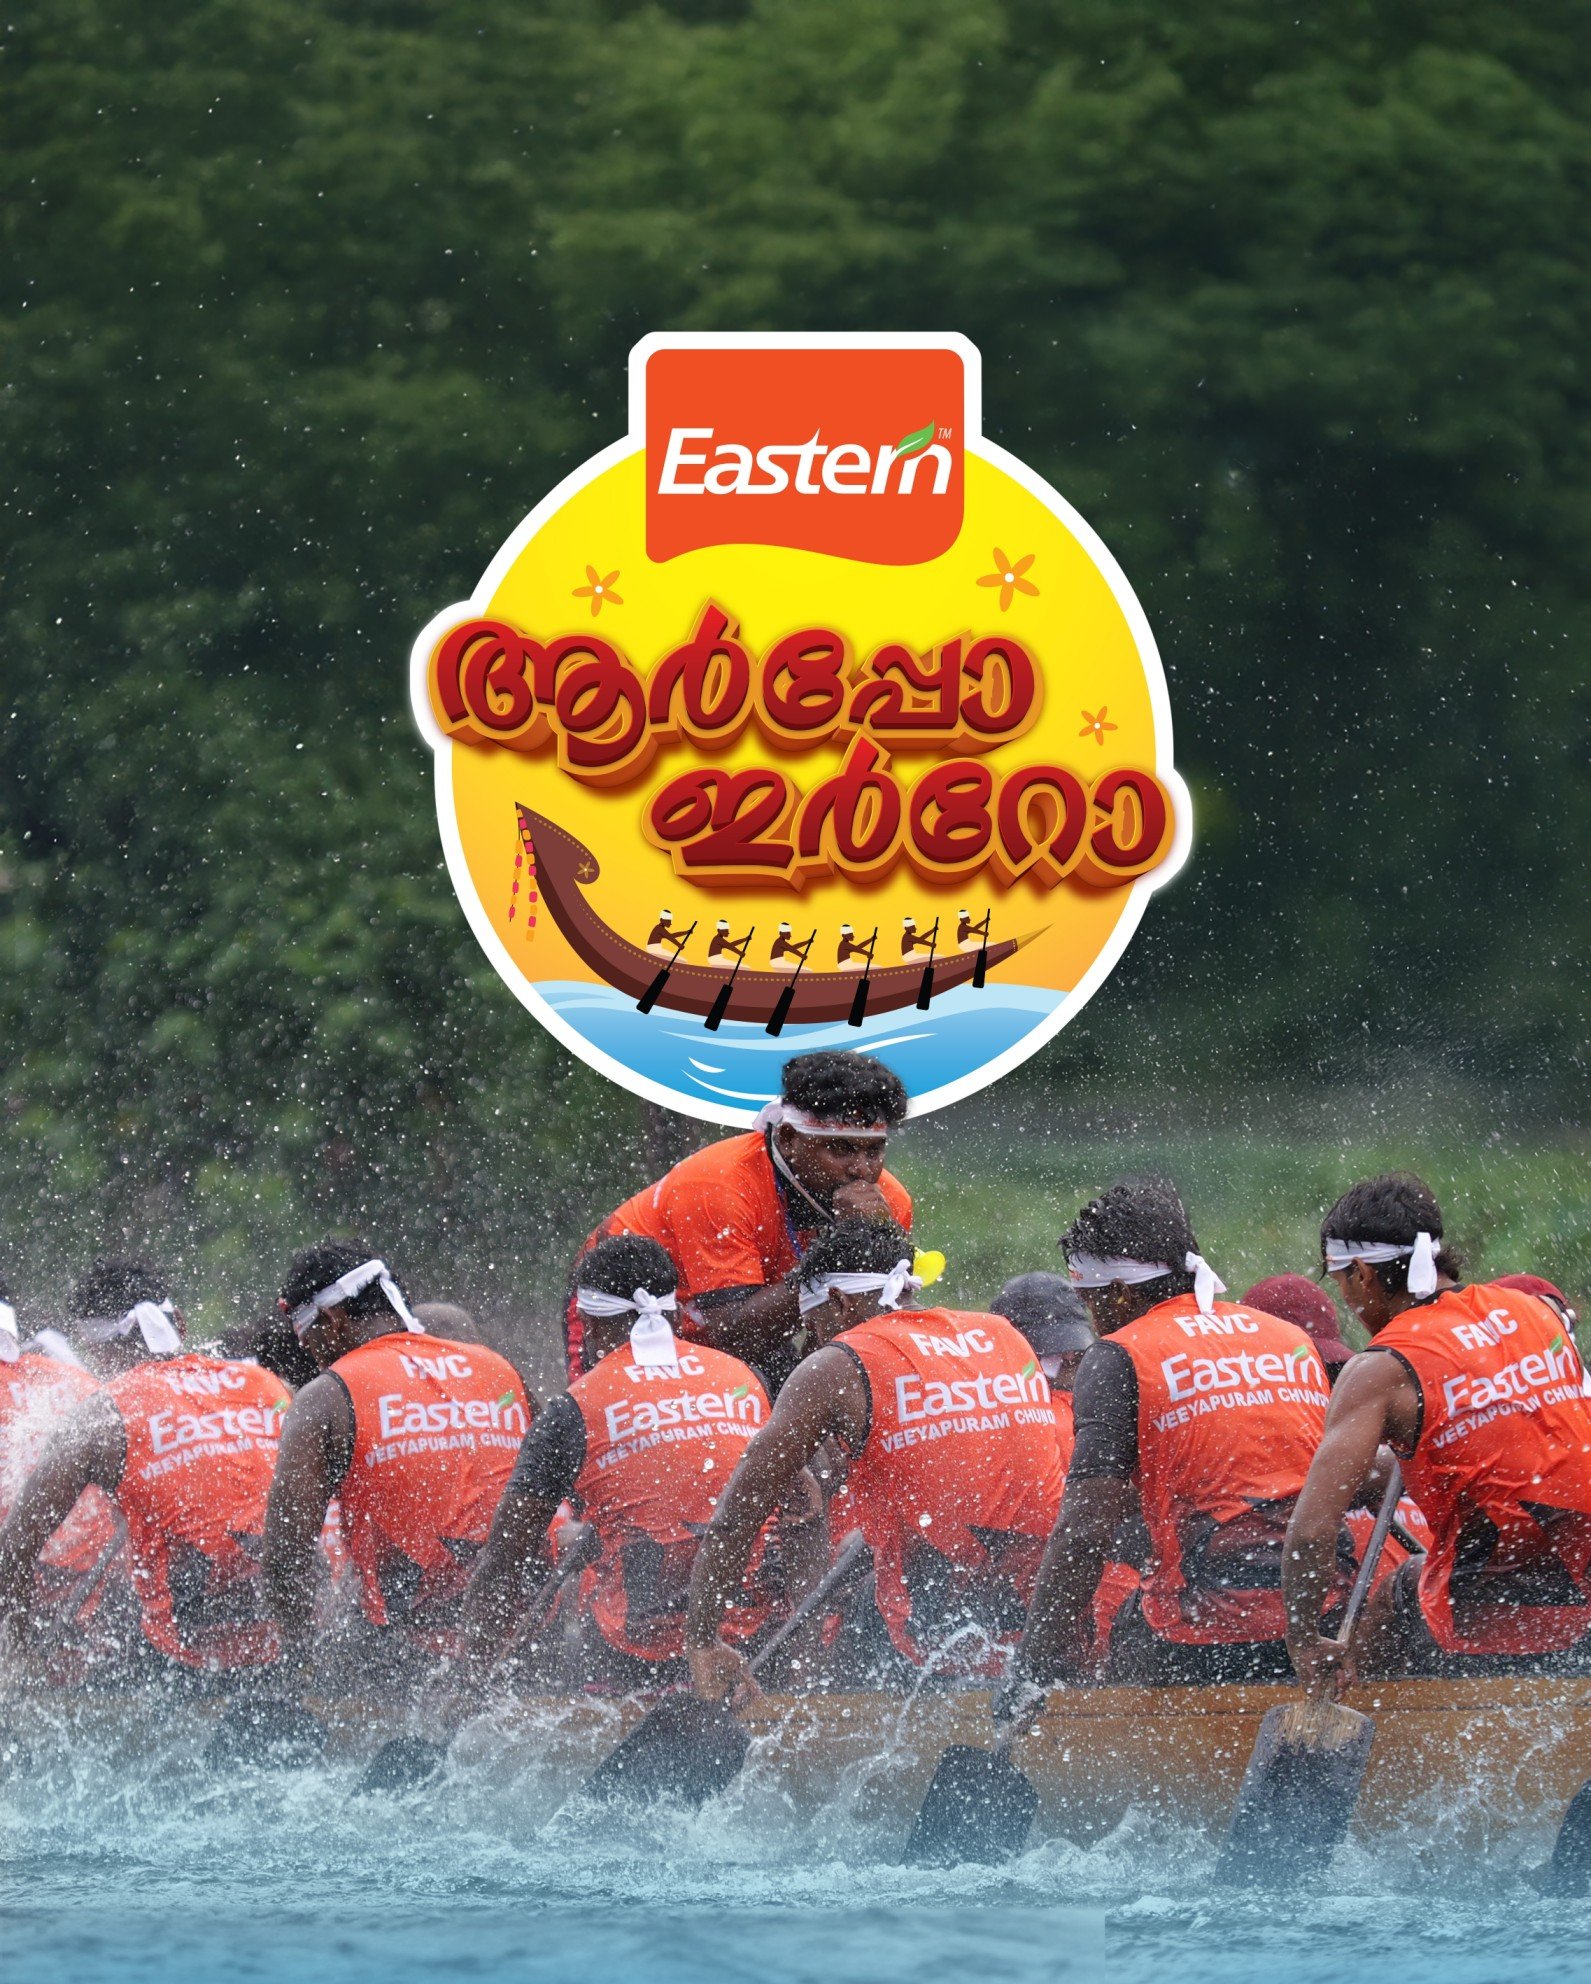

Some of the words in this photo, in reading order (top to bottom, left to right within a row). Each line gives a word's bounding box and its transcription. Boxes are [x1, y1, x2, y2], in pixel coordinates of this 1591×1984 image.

[909, 1328, 995, 1358] FAVC
[1174, 1313, 1259, 1337] FAVC
[623, 1355, 705, 1383] FAVC
[1160, 1349, 1322, 1402] Eastern
[1442, 1344, 1577, 1418] Eastern
[378, 1393, 526, 1439] Eastern
[604, 1390, 761, 1443] Eastern
[895, 1370, 1051, 1423] Eastern
[1152, 1388, 1275, 1433] VEEYAPURAM
[595, 1423, 713, 1470] VEEYAPURAM
[880, 1412, 1011, 1454] VEEYAPURAM
